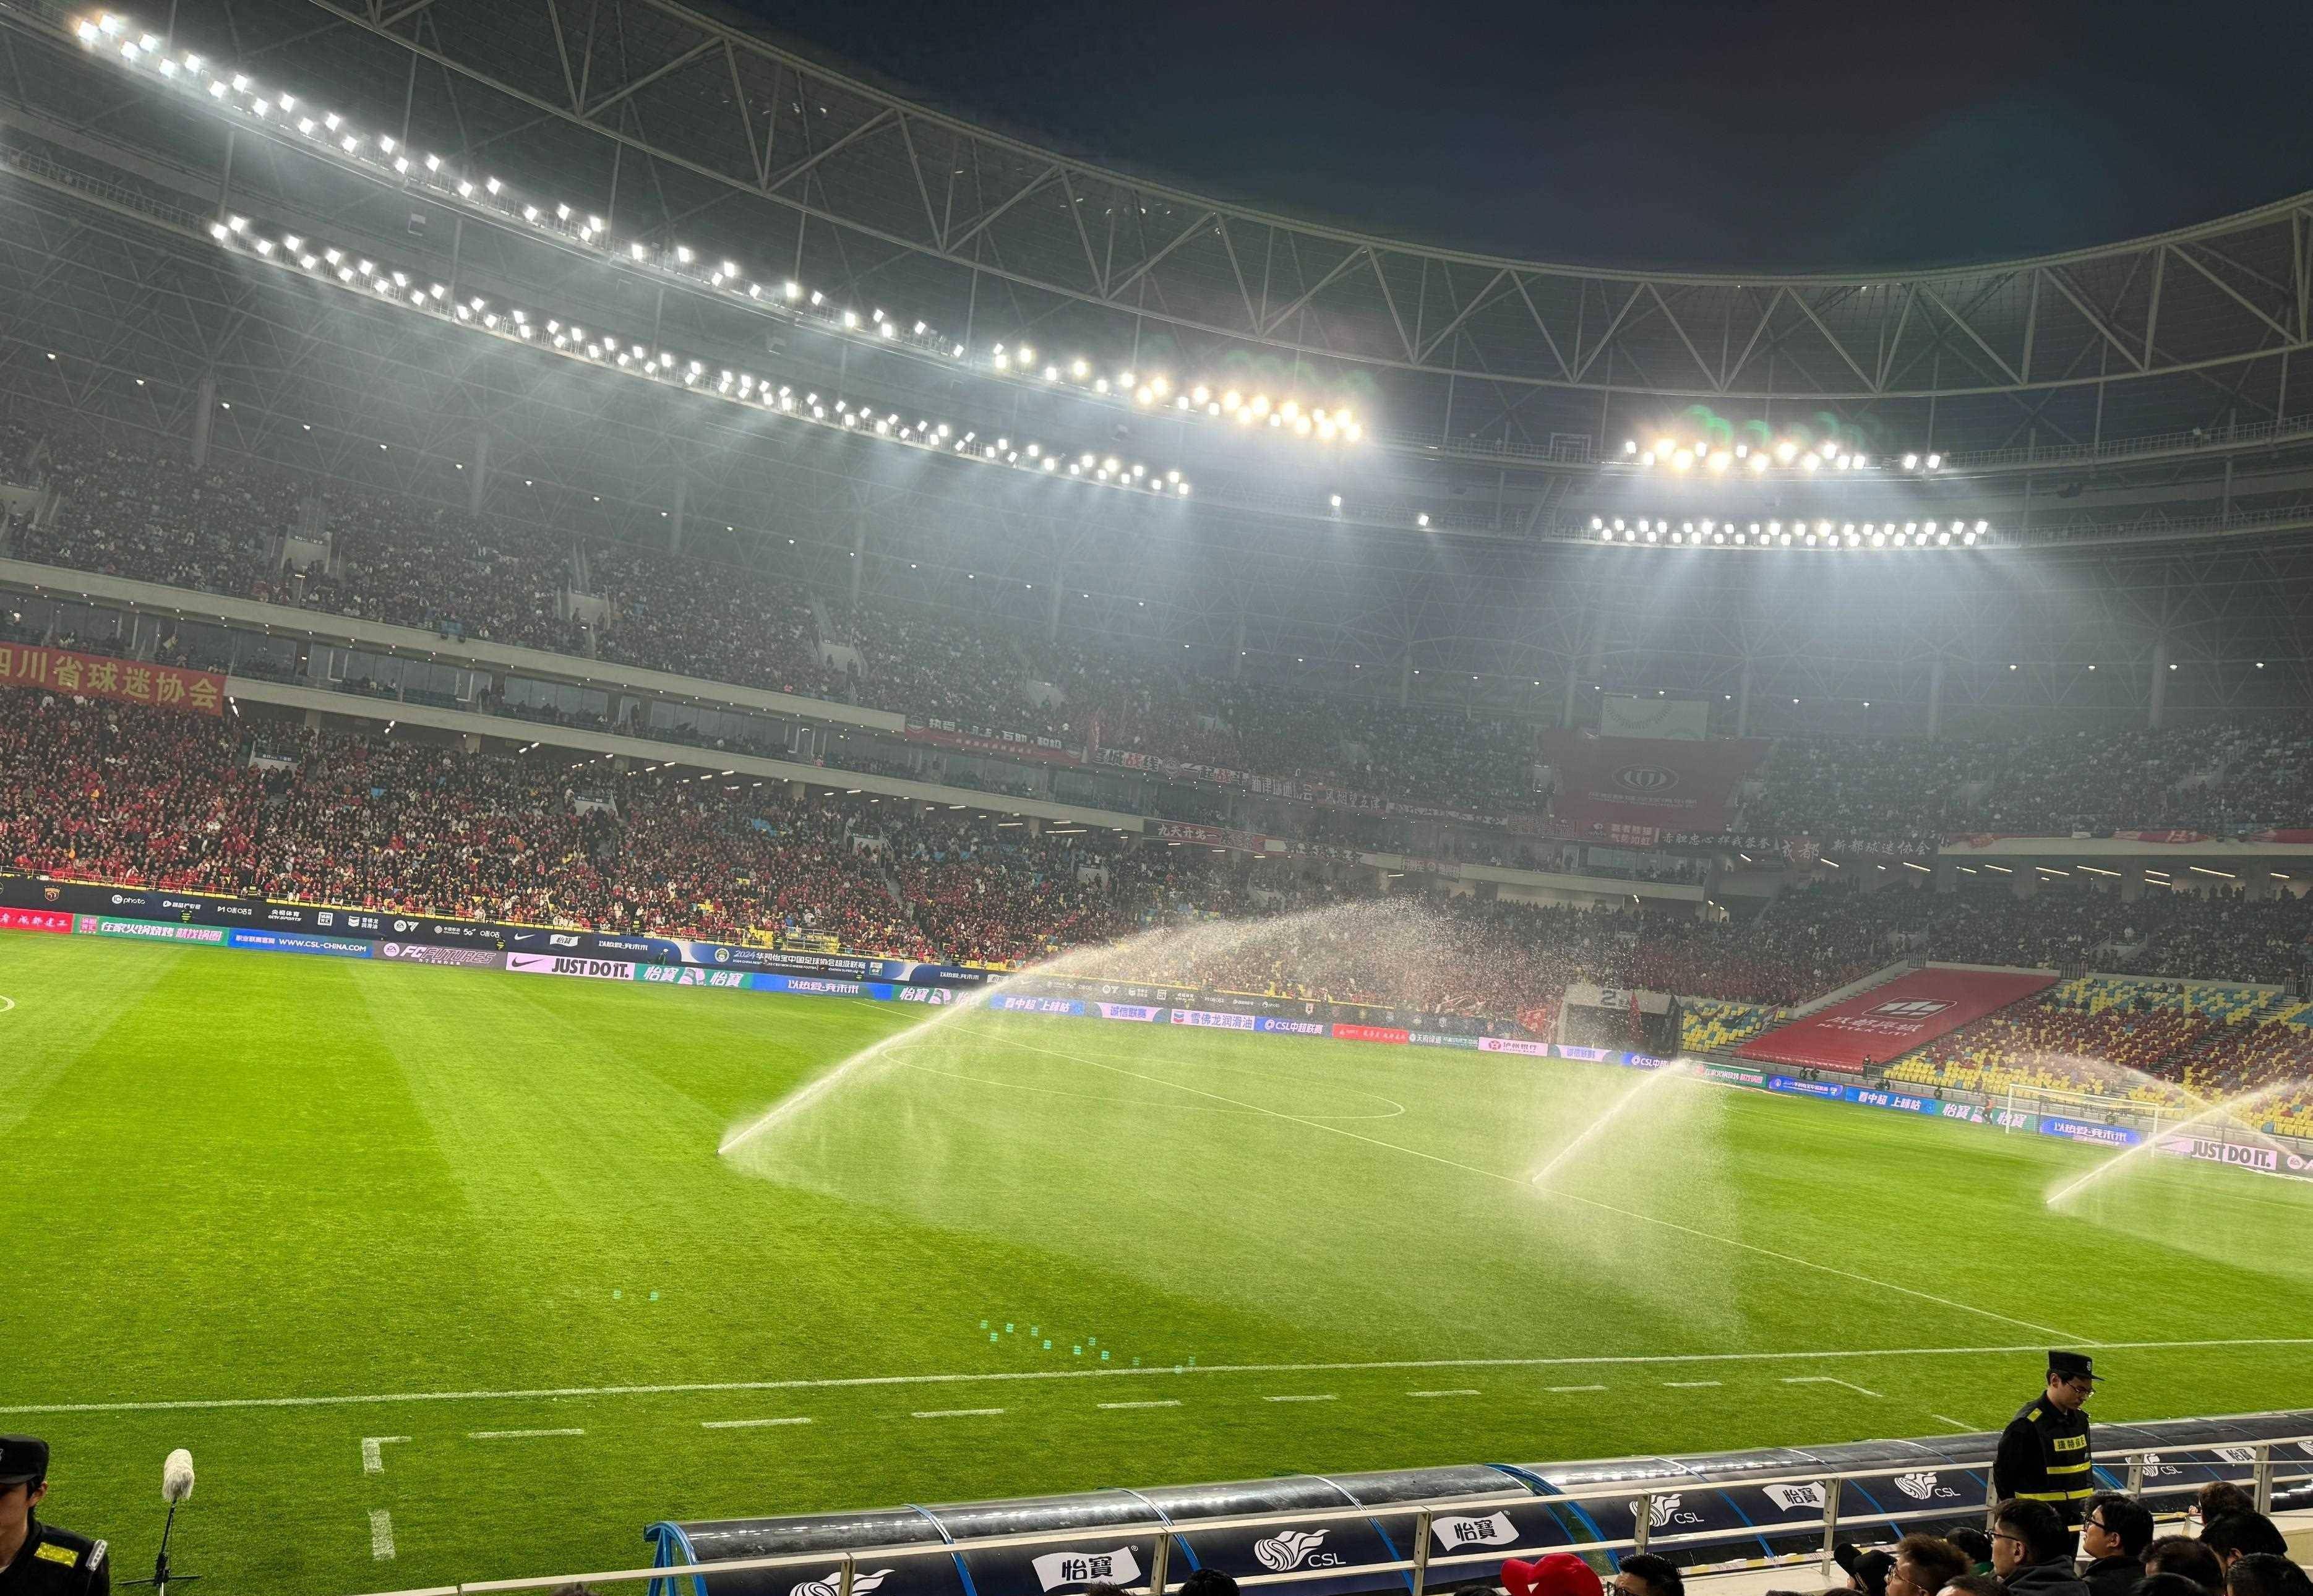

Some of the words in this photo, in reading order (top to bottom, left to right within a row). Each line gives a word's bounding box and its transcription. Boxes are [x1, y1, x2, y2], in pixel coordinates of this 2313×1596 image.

[278, 938, 367, 952] WWW.CSL-CHINA.COM
[552, 958, 588, 975] JUST
[589, 962, 612, 976] DO
[613, 963, 630, 979] IT.
[1191, 1013, 1253, 1029] 雪佛龙润滑油
[2191, 1140, 2226, 1161] JUST
[2228, 1146, 2251, 1164] DO
[2254, 1150, 2271, 1167] IT.
[2160, 1465, 2182, 1475] CSL
[1783, 1488, 1821, 1504] 怡寶
[1935, 1486, 1961, 1498] CSL
[1675, 1511, 1704, 1524] CSL
[1453, 1519, 1498, 1542] 怡寶
[1308, 1552, 1346, 1568] CSL
[1062, 1556, 1114, 1581] 怡寶
